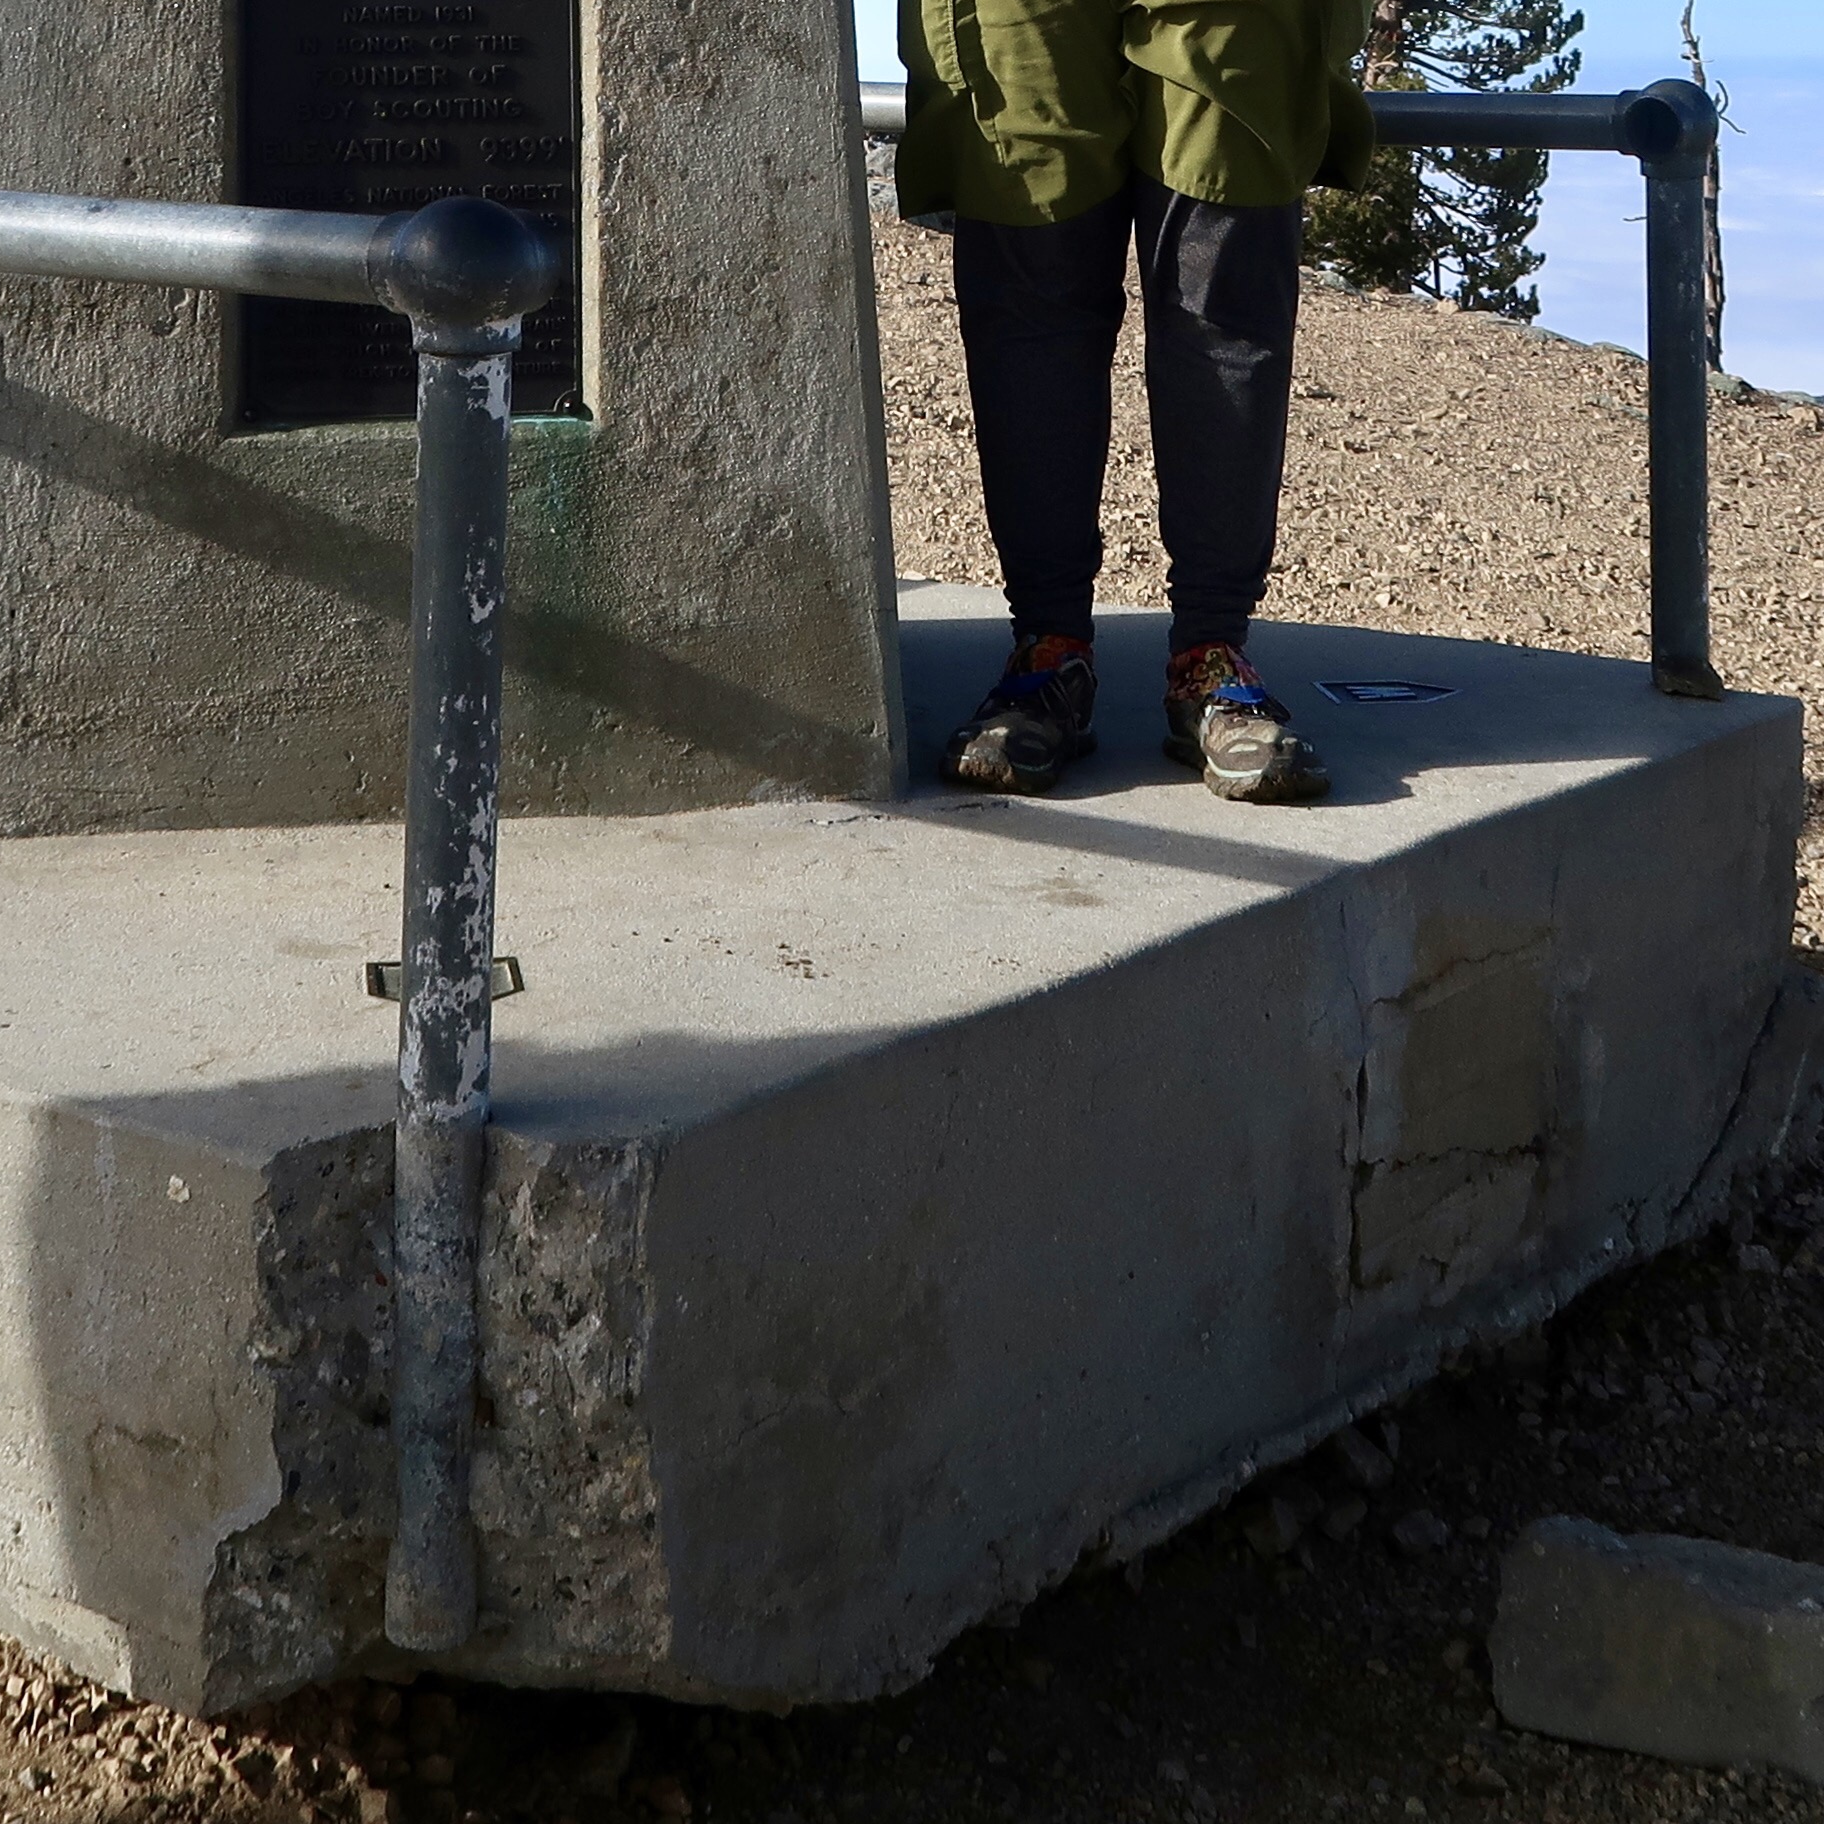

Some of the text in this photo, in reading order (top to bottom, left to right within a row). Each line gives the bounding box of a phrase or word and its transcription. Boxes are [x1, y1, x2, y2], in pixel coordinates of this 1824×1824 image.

[342, 4, 475, 24] NAMED 1931
[295, 34, 523, 55] IN HONOR OF THE
[310, 63, 508, 87] FOUNDER OF
[296, 97, 524, 123] BOY SCOUTING
[261, 136, 444, 165] ELEVATION
[257, 187, 356, 206] ANGELES
[480, 183, 564, 204] FOREST
[534, 337, 562, 352] OF
